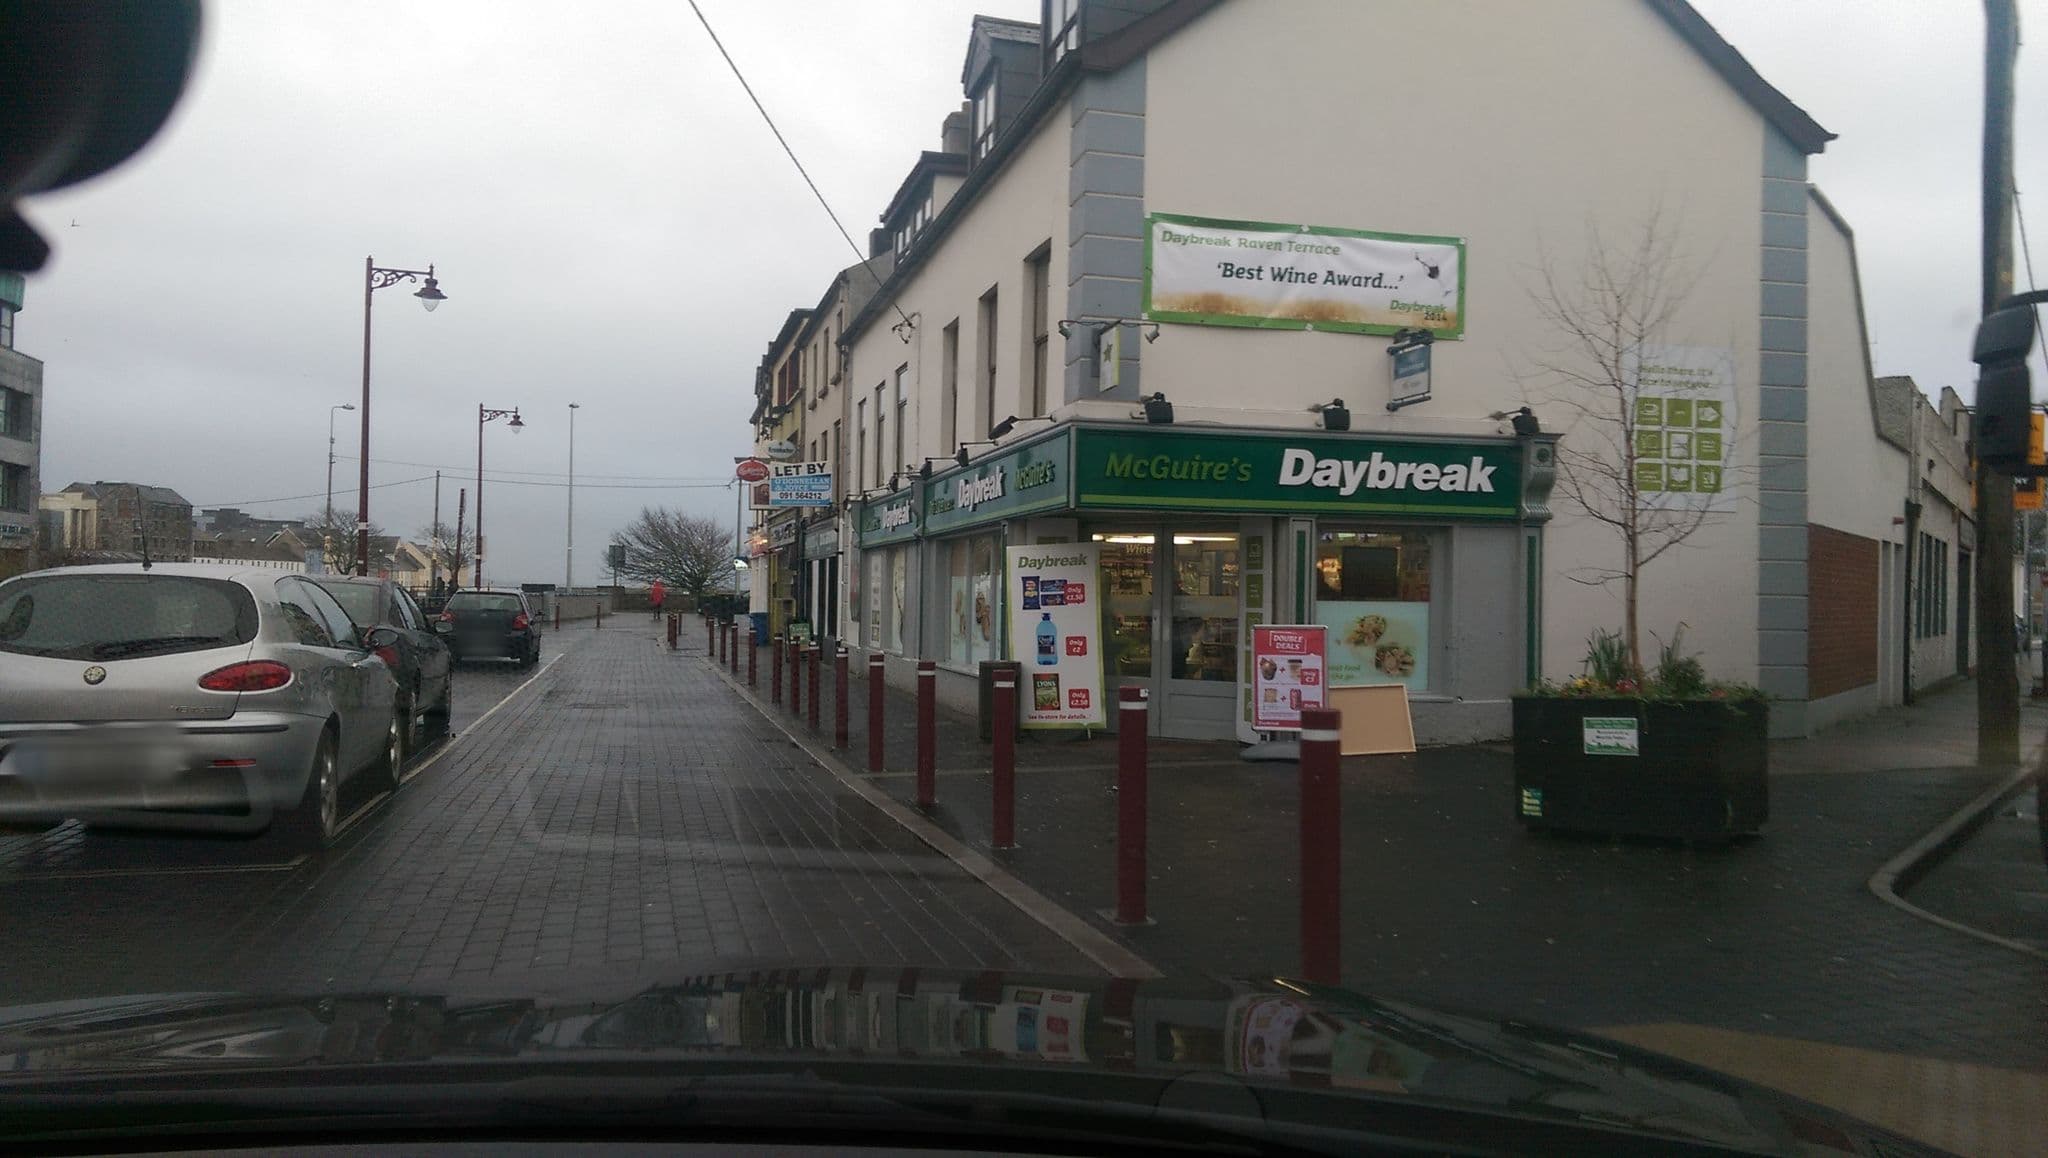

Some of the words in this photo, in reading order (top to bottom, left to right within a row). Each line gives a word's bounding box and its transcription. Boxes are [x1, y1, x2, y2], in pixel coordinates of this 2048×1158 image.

[1161, 230, 1231, 248] Daybreak
[1238, 238, 1283, 251] Raven
[1287, 241, 1341, 256] Terrace
[1270, 267, 1318, 285] Wine
[1390, 299, 1447, 313] Daybreak
[1423, 312, 1448, 321] 2014
[775, 465, 801, 477] LET
[807, 463, 827, 474] BY
[1105, 452, 1253, 483] McGuire's
[1278, 448, 1498, 496] Daybreak
[795, 492, 822, 500] 564212
[958, 467, 1004, 511] Daybreak
[882, 500, 911, 531] Daybreak
[1017, 553, 1088, 570] Daybreak
[1273, 634, 1304, 643] DOUBLE
